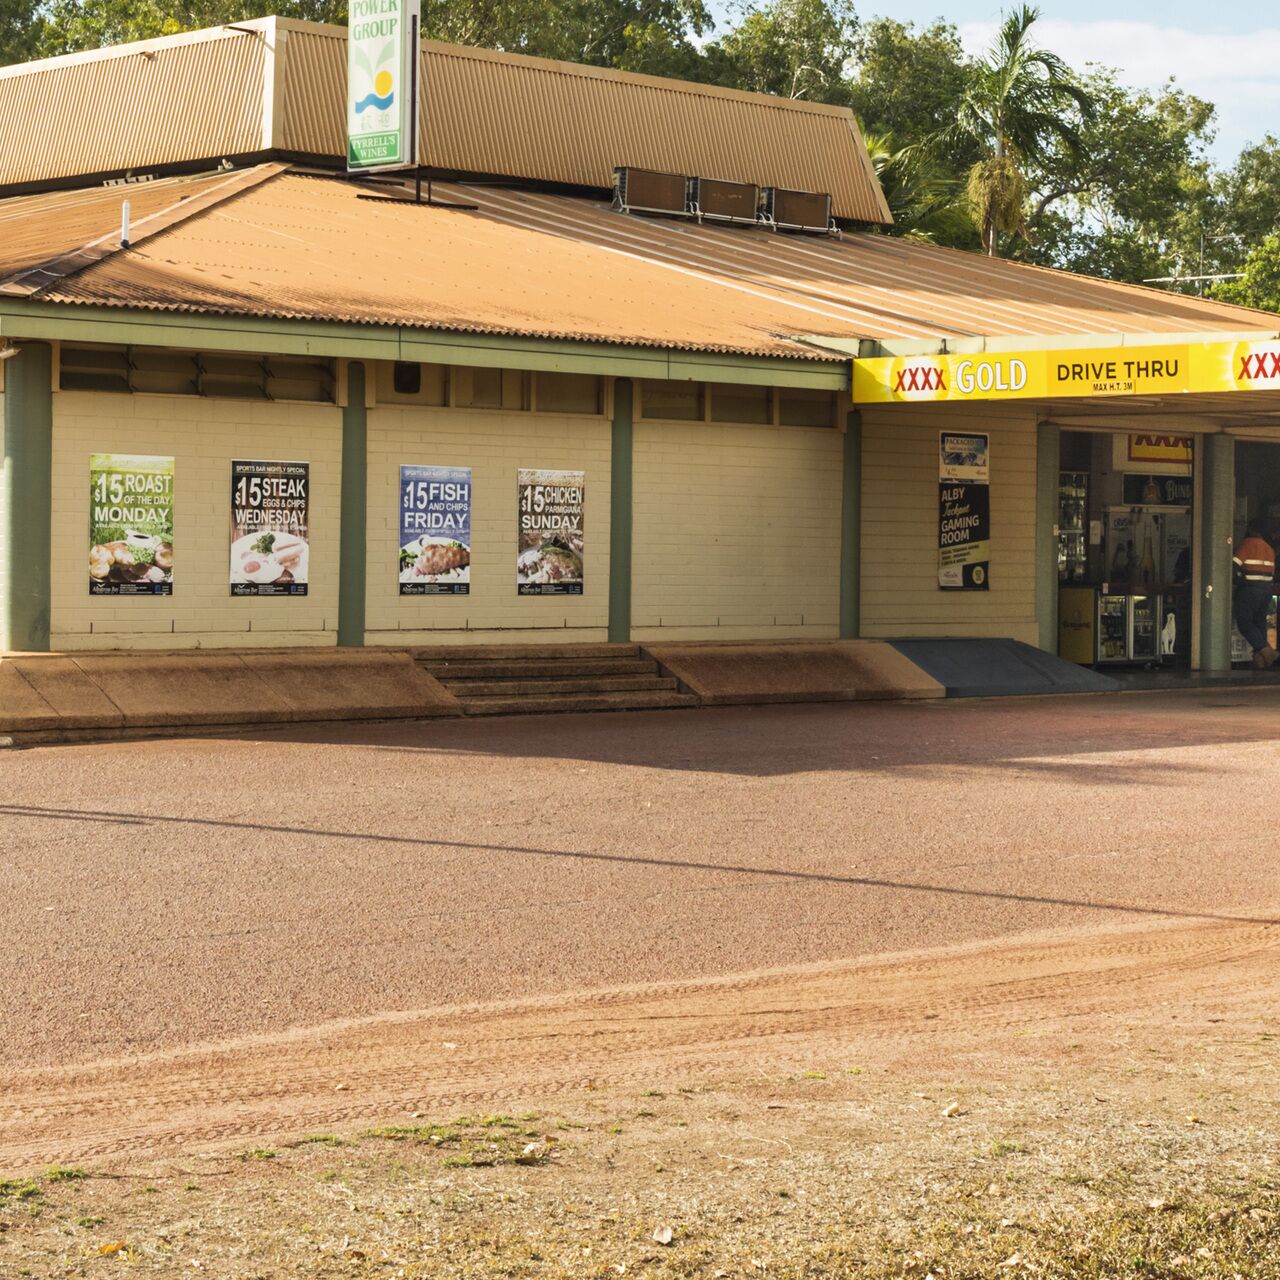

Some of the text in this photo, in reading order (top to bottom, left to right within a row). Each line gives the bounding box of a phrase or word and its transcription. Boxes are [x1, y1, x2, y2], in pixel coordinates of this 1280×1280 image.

[352, 18, 398, 41] GROUP
[360, 147, 388, 158] WINES
[894, 359, 1027, 394] XXXX GOLD
[1057, 360, 1179, 381] DRIVE THRU
[1092, 383, 1108, 392] MAX
[236, 465, 255, 473] SPORTS
[94, 473, 123, 503] $15
[125, 474, 172, 493] ROAST
[262, 478, 306, 497] STEAK
[124, 495, 170, 505] OF THE DAY
[235, 477, 262, 507] $15
[404, 481, 428, 509] $15
[429, 483, 468, 501] FISH
[521, 486, 545, 512] $15
[545, 487, 582, 504] CHICKEN
[941, 487, 966, 502] ALBY
[262, 499, 306, 508] EGGS & CHIPS
[428, 503, 468, 511] AND CHIPS
[94, 507, 169, 522] MONDAY
[235, 509, 306, 525] WEDNESDAY
[404, 512, 467, 528] FRIDAY
[522, 515, 580, 529] SUNDAY
[941, 515, 979, 532] GAMING
[941, 529, 970, 545] ROOM
